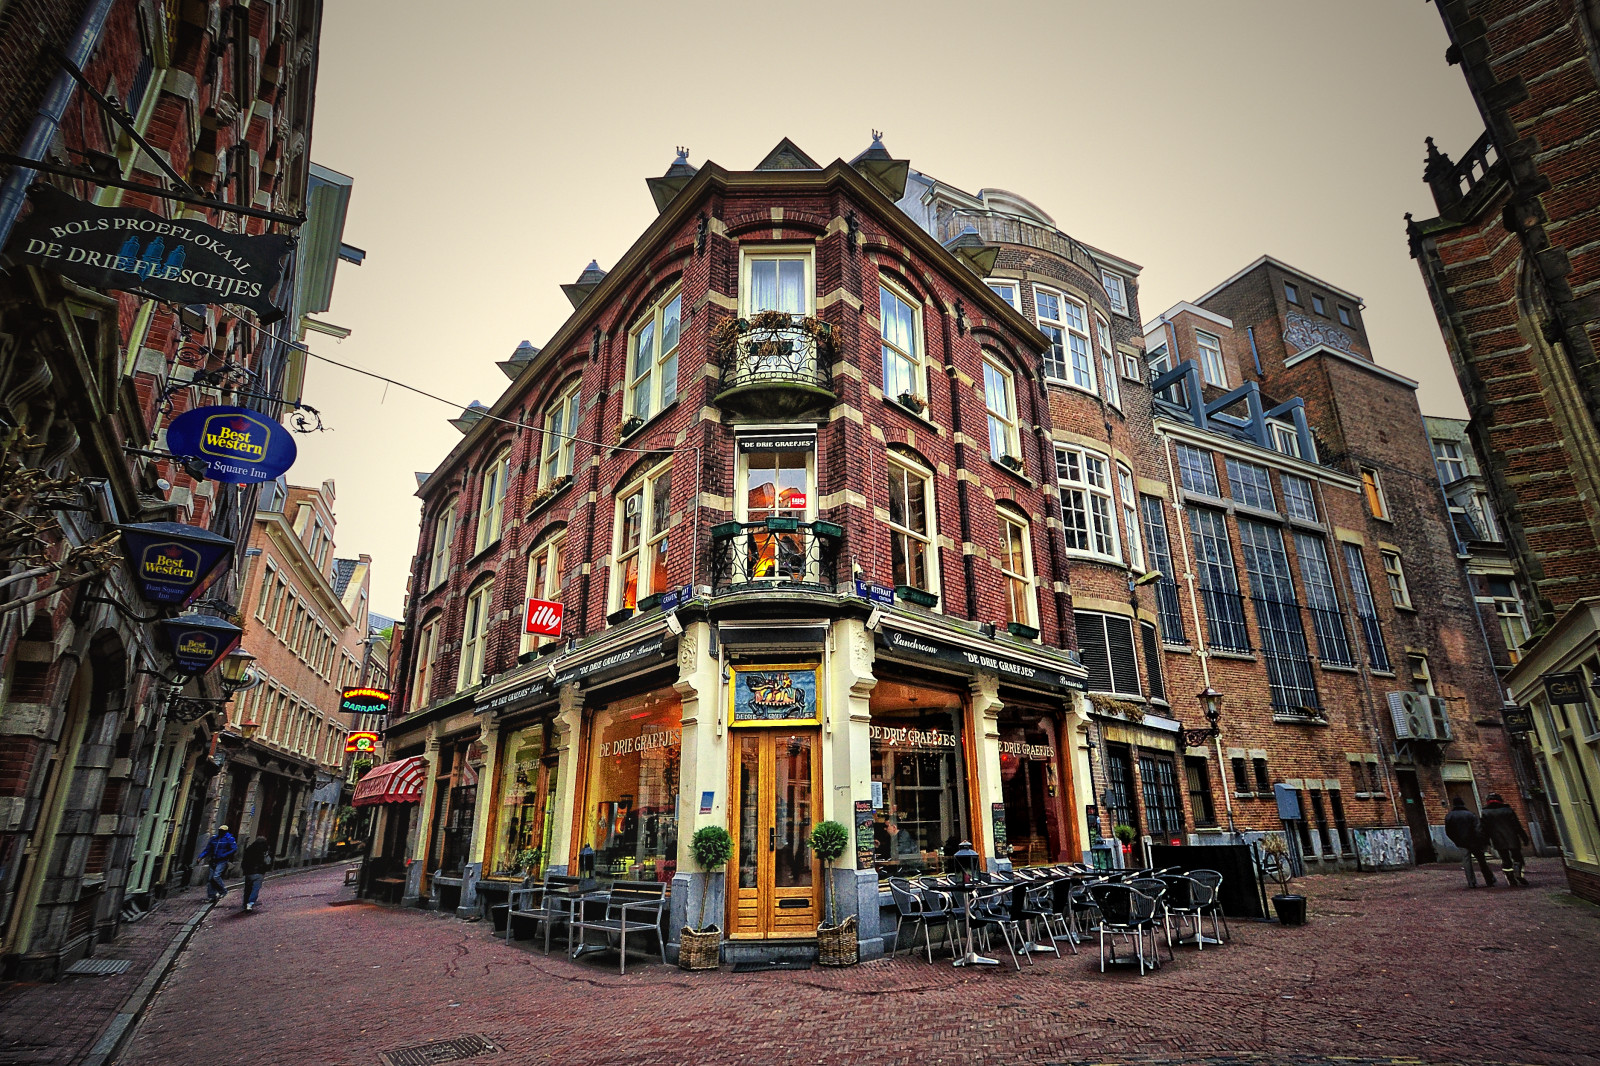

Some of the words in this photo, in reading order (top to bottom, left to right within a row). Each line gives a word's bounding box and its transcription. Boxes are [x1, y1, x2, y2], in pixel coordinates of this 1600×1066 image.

[50, 217, 110, 239] BOLS
[113, 217, 252, 276] PROEFLOKAAL
[25, 238, 63, 259] DE
[67, 246, 129, 272] DRIE
[133, 263, 263, 298] FLESCHJES
[220, 426, 252, 443] Best
[206, 433, 263, 455] Western
[213, 460, 249, 475] Square
[250, 467, 268, 479] Inn
[145, 561, 195, 578] Western
[156, 554, 185, 568] Best
[162, 586, 185, 596] Square
[531, 604, 561, 631] illy
[179, 645, 214, 656] Western
[187, 639, 207, 648] Best
[979, 655, 998, 669] DRIE
[343, 701, 387, 712] BARRAKA
[598, 742, 611, 758] DE
[612, 737, 634, 757] DRIE
[634, 728, 681, 753] GRAEFJES
[869, 725, 882, 739] DE
[881, 726, 906, 746] DRIE
[907, 730, 956, 748] GRAEFJES
[1003, 741, 1021, 758] DRIE
[1021, 743, 1055, 760] GRAEFJES
